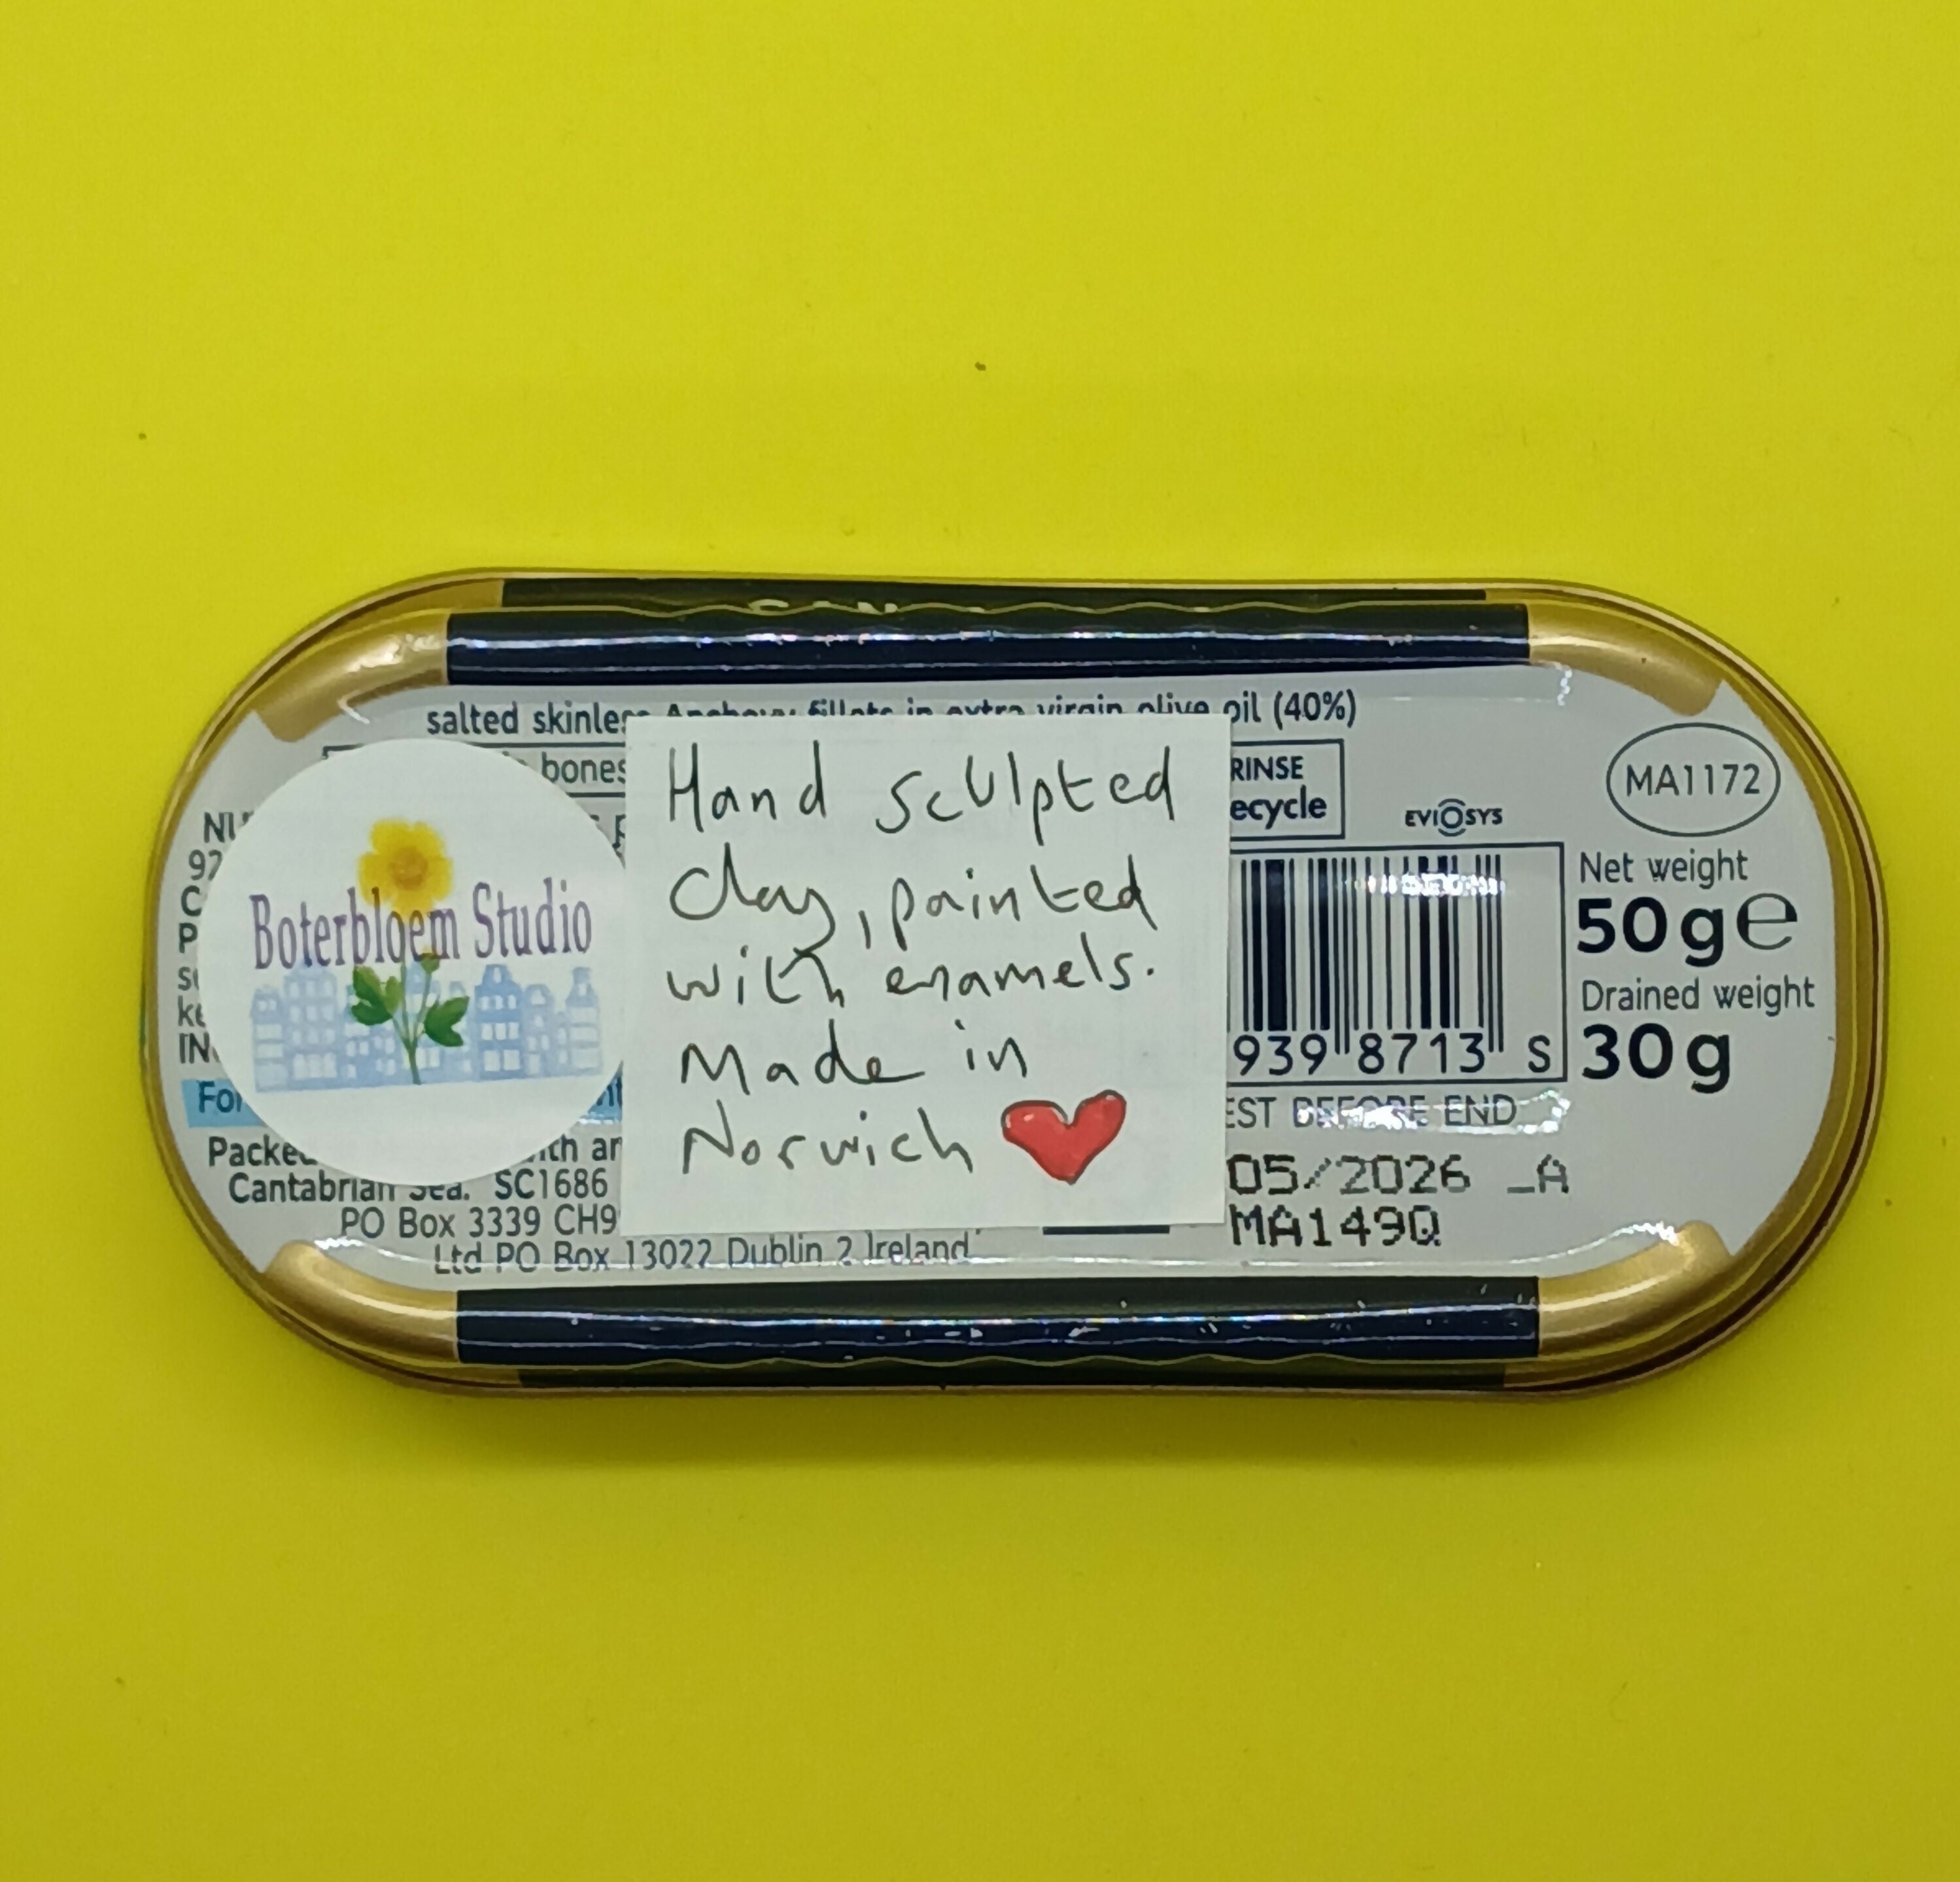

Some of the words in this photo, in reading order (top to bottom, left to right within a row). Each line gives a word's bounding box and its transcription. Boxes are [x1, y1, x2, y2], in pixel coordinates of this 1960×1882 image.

[427, 701, 519, 735] salted
[532, 701, 651, 735] skinle
[1224, 690, 1262, 723] oil
[1274, 689, 1356, 730] (40%)
[670, 741, 827, 832] Hand
[1230, 756, 1303, 782] RINSE
[1626, 763, 1761, 797] MA1172
[1230, 785, 1327, 829] ecycle
[1405, 803, 1503, 833] EVIOSYS
[1580, 852, 1634, 883] Net
[1647, 848, 1749, 890] weight
[250, 887, 460, 970] Boterbloem
[472, 877, 593, 959] Studio
[893, 856, 1158, 950] painted
[667, 945, 845, 1007] with
[885, 932, 1155, 998] enamels.
[1582, 977, 1699, 1011] Drained
[1713, 975, 1815, 1017] weight
[680, 1017, 925, 1096] Made
[954, 1019, 1028, 1078] in
[1358, 1033, 1485, 1074] 8713
[1528, 1035, 1551, 1073] S
[1582, 1023, 1730, 1094] 30g
[1226, 1098, 1277, 1128] EST
[1445, 1094, 1517, 1127] END
[682, 1099, 974, 1174] Norwich
[229, 1170, 396, 1203] Cantabrian
[494, 1168, 608, 1200] SC1686
[1227, 1155, 1470, 1194] 05/2026
[341, 1206, 385, 1238] PO
[399, 1207, 455, 1238] Box
[469, 1205, 540, 1238] 3339
[555, 1203, 621, 1236] CH9
[434, 1242, 482, 1274] Ltd
[497, 1242, 540, 1274] PO
[555, 1240, 610, 1273] Box
[728, 1233, 823, 1268] Dublin
[865, 1229, 970, 1266] Ireland
